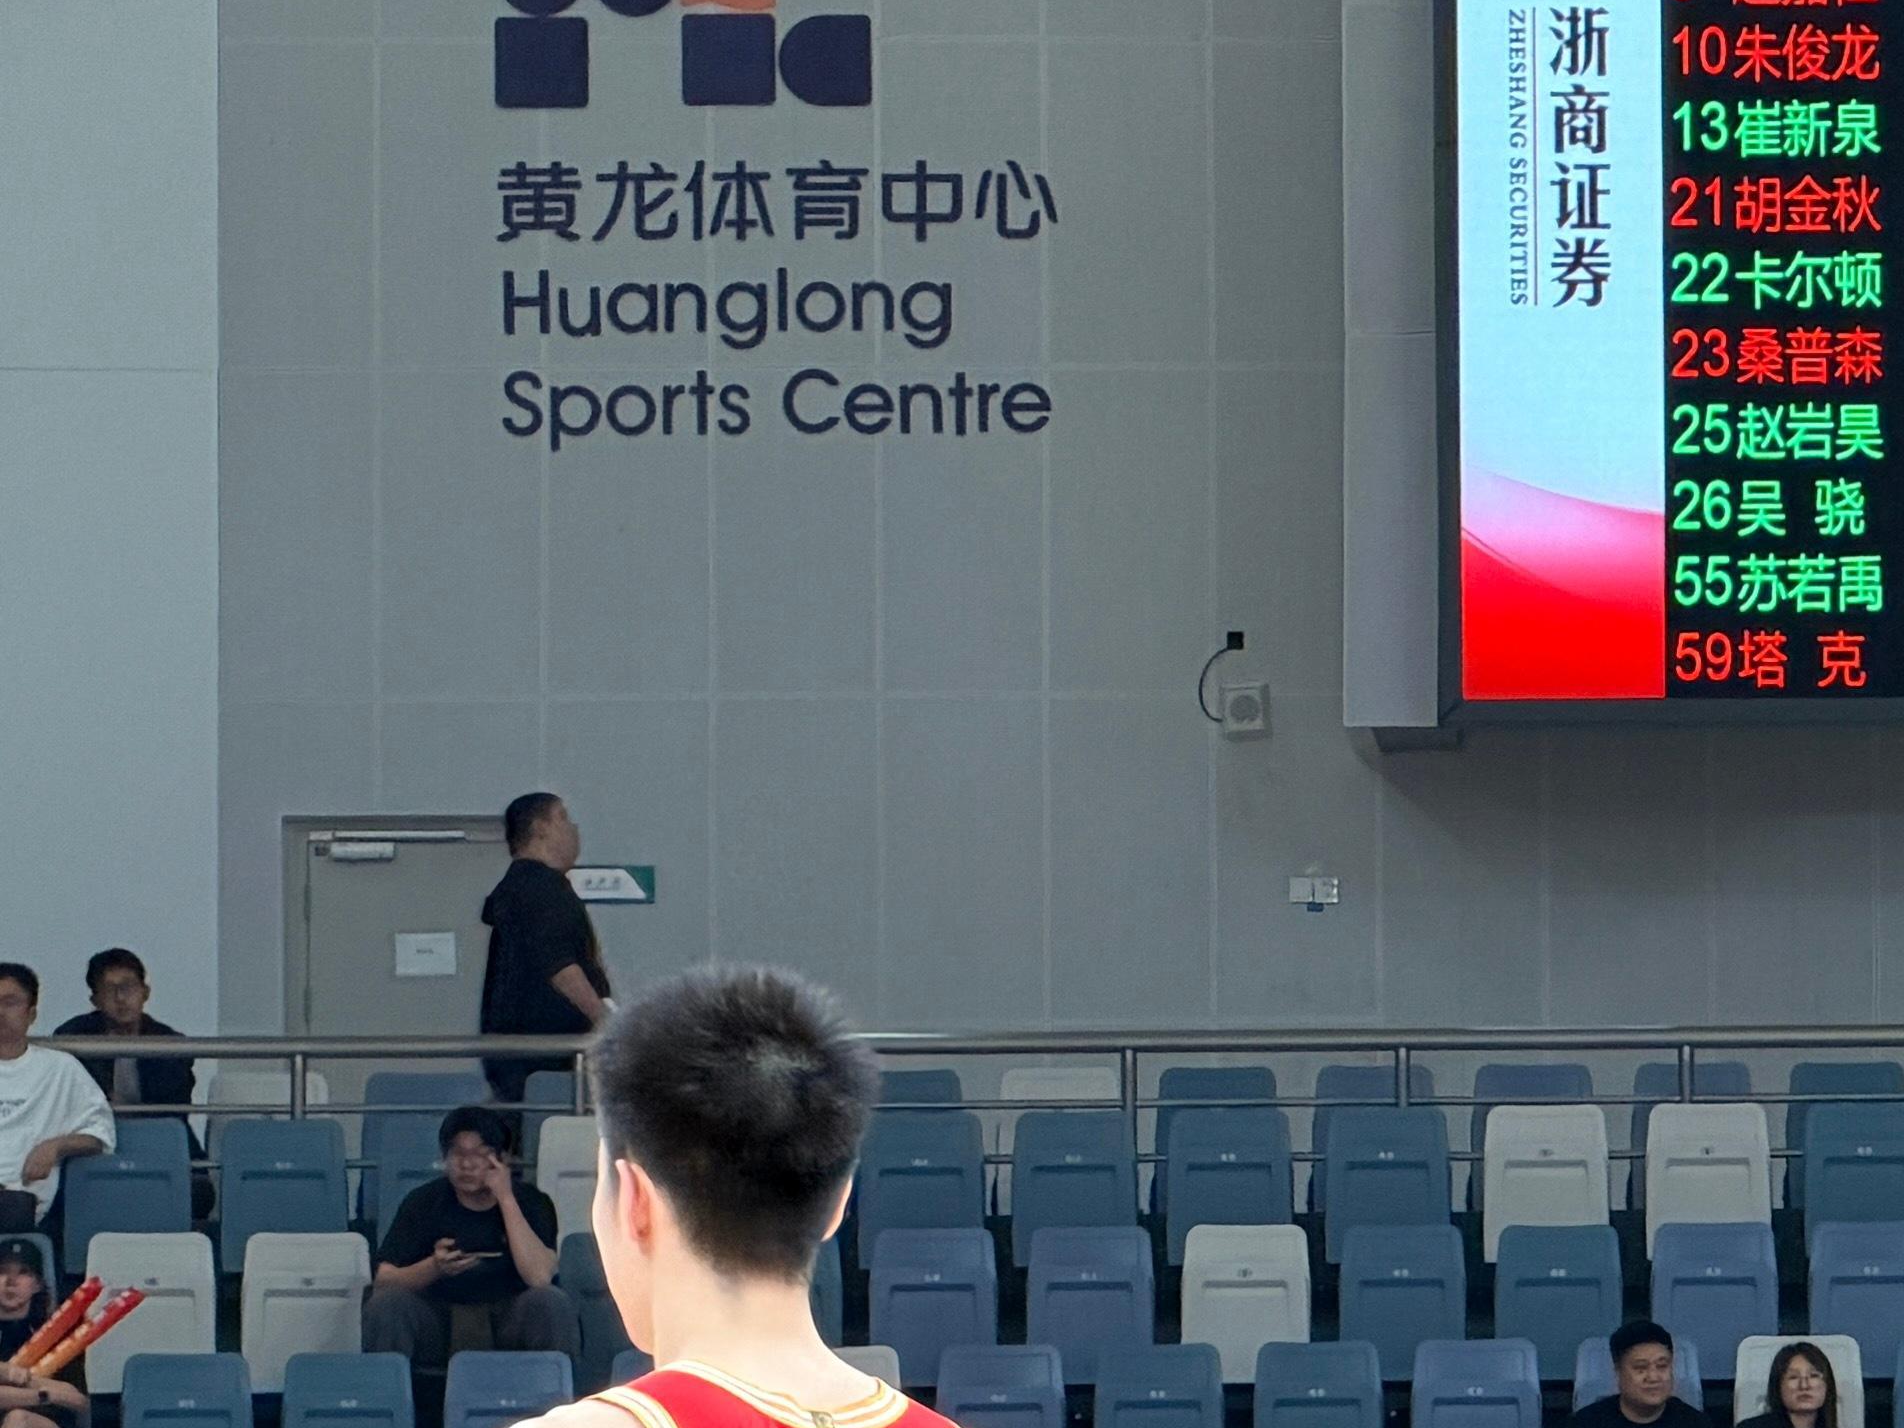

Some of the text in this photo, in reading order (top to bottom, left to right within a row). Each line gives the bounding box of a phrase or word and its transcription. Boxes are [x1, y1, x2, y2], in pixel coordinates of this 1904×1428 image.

[1673, 26, 1727, 74] 10
[1734, 24, 1879, 82] 朱俊龙
[1508, 9, 1528, 306] ZHESHANG SECURITIES
[1549, 6, 1611, 308] 浙商证券
[1673, 101, 1728, 151] 13
[1734, 99, 1881, 158] 崔新泉
[497, 160, 1058, 242] 黄龙体育中心
[1671, 177, 1720, 226] 21
[1734, 175, 1881, 233] 胡金秋
[503, 267, 952, 350] Huanglong
[1671, 252, 1729, 302] 22
[1735, 251, 1882, 309] 卡尔顿
[1672, 329, 1730, 377] 23
[1737, 326, 1882, 384] 桑普森
[503, 369, 1052, 452] Sports Centre
[1672, 404, 1731, 454] 25
[1736, 402, 1884, 460] 赵岩昊
[1673, 480, 1731, 530] 26
[1675, 556, 1733, 606] 55
[1738, 553, 1882, 612] 苏若禹
[1676, 632, 1732, 681] 59
